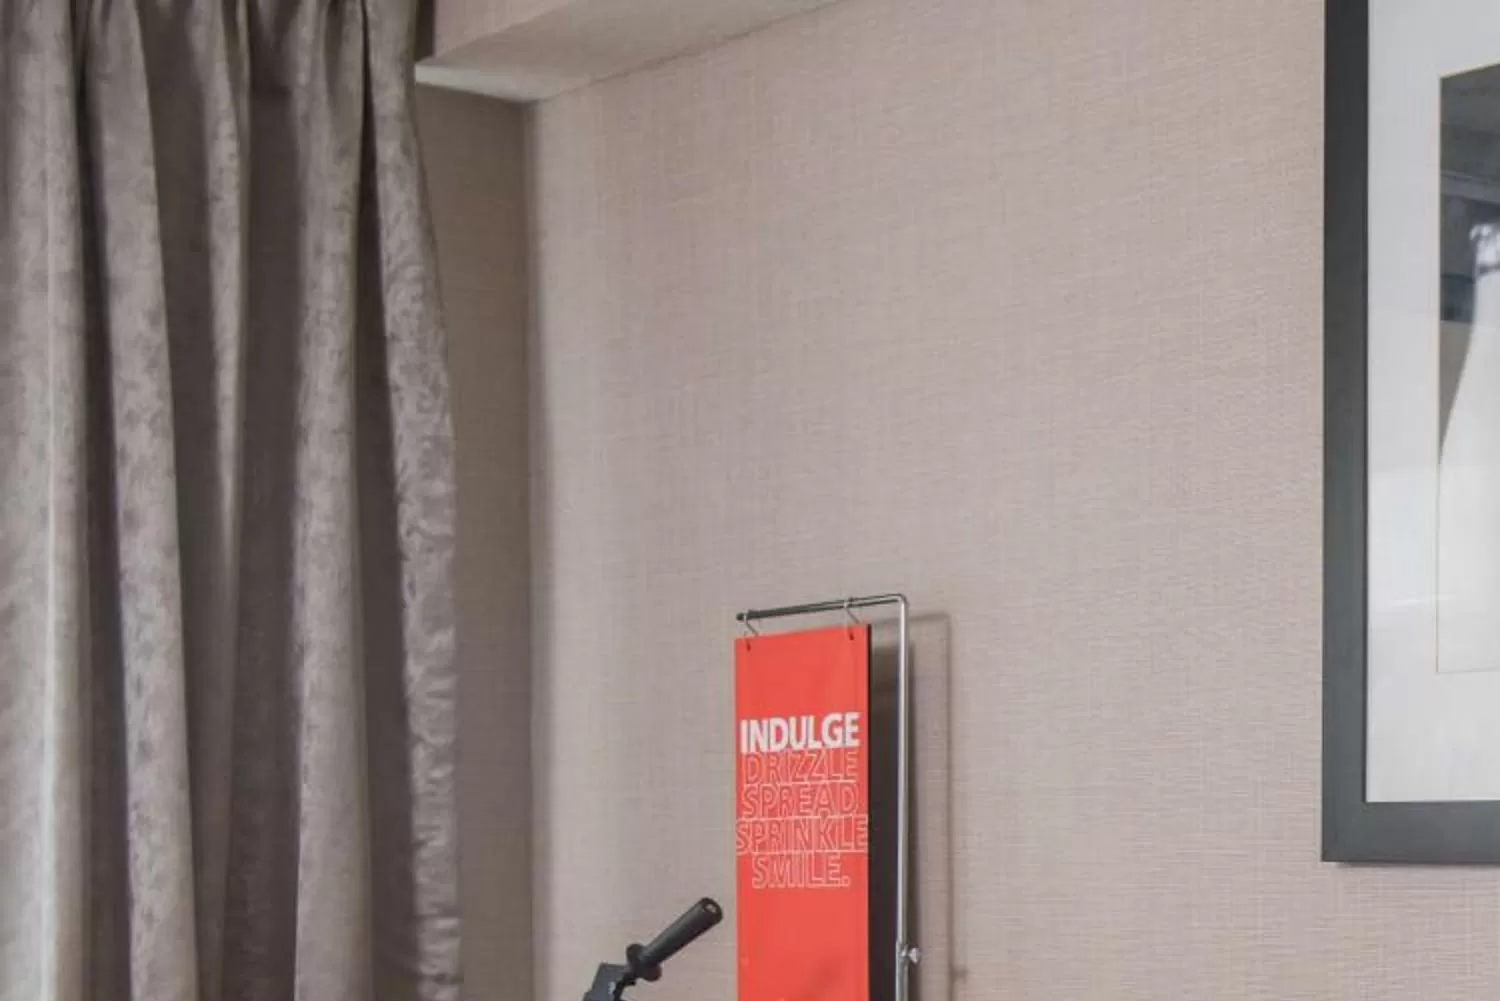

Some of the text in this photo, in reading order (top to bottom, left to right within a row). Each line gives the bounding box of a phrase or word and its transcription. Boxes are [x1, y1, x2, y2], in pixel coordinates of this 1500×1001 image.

[740, 712, 861, 752] INDULGE
[743, 748, 857, 785] DRIZZLE
[741, 781, 859, 820] SPREAD
[736, 815, 868, 856] SPRINKLE
[752, 849, 851, 889] SMILE.
